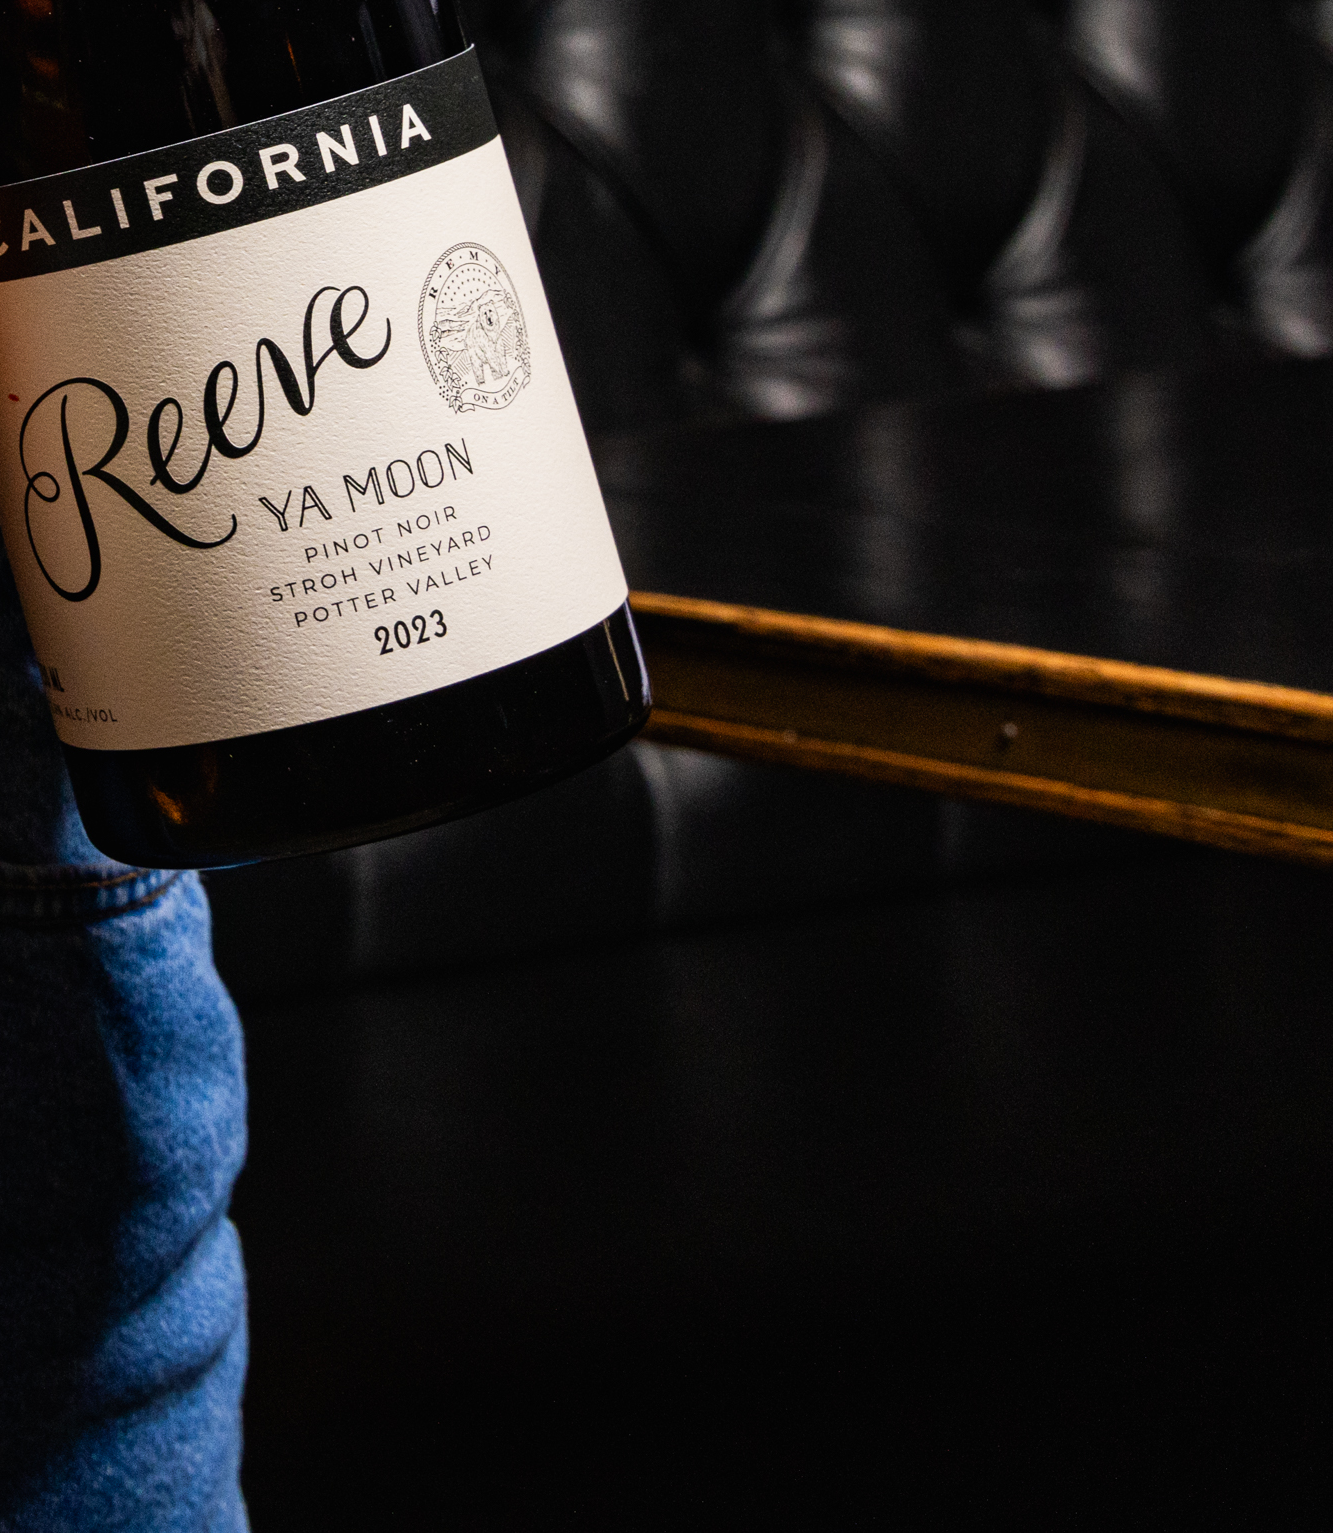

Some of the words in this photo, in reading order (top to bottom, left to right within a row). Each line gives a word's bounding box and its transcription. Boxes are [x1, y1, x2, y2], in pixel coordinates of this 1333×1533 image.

[473, 393, 489, 405] ON
[501, 377, 519, 402] TILT
[19, 285, 391, 602] Reeve
[258, 485, 332, 532] YA
[343, 437, 474, 513] MOON
[270, 567, 357, 602] STROH
[369, 525, 491, 575] VINEYARD
[304, 527, 383, 563] PINOT
[397, 505, 457, 537] NOIR
[294, 587, 396, 627] POTTER
[407, 554, 493, 595] VALLEY
[374, 609, 448, 655] 2023
